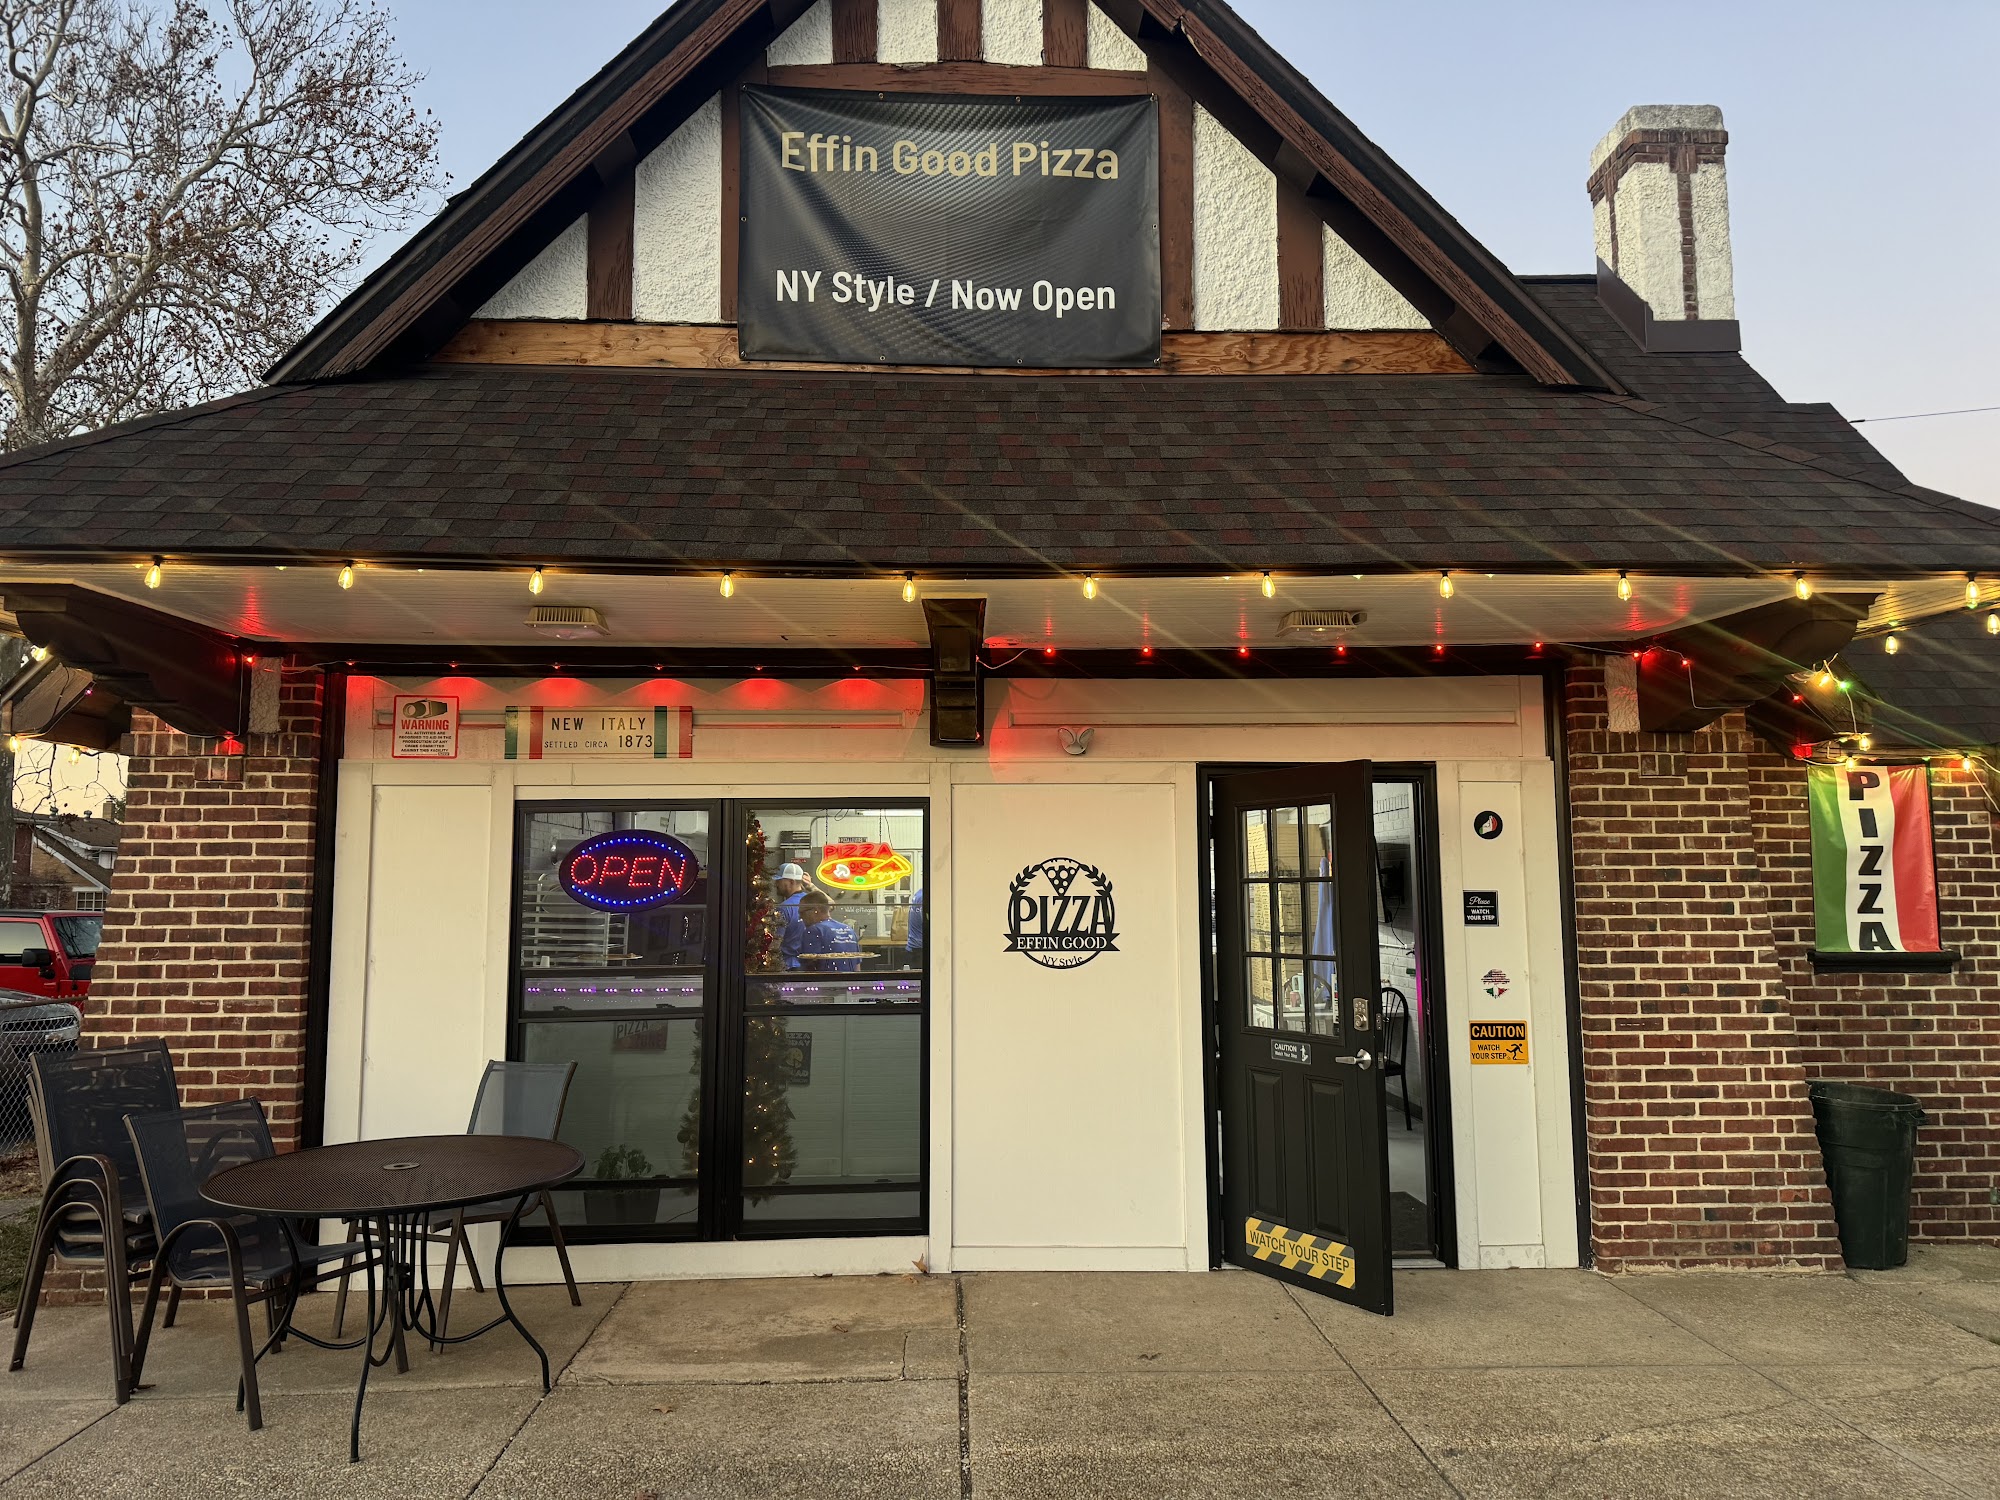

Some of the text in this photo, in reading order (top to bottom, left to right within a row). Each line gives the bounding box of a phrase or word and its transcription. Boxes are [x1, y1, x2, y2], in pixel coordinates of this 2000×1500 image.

[781, 131, 1119, 180] Effin Good Pizza
[776, 269, 1116, 319] NY Style / Now Open
[401, 719, 449, 730] WARNING
[551, 717, 646, 730] NEW ITALY
[544, 741, 578, 749] SETTLED
[618, 735, 653, 748] 1873
[824, 844, 892, 859] PIZZA
[1846, 771, 1898, 951] PIZZA
[570, 854, 687, 890] OPEN
[1469, 896, 1491, 905] Please
[1013, 895, 1112, 935] PIZZA
[1016, 936, 1107, 949] EFFIN GOOD
[1041, 955, 1083, 966] NY Style
[616, 1021, 649, 1039] PIZZA
[1471, 1025, 1525, 1038] CAUTION
[1274, 1043, 1298, 1052] CAUTION
[1250, 1230, 1350, 1272] WATCH YOUR STEP
